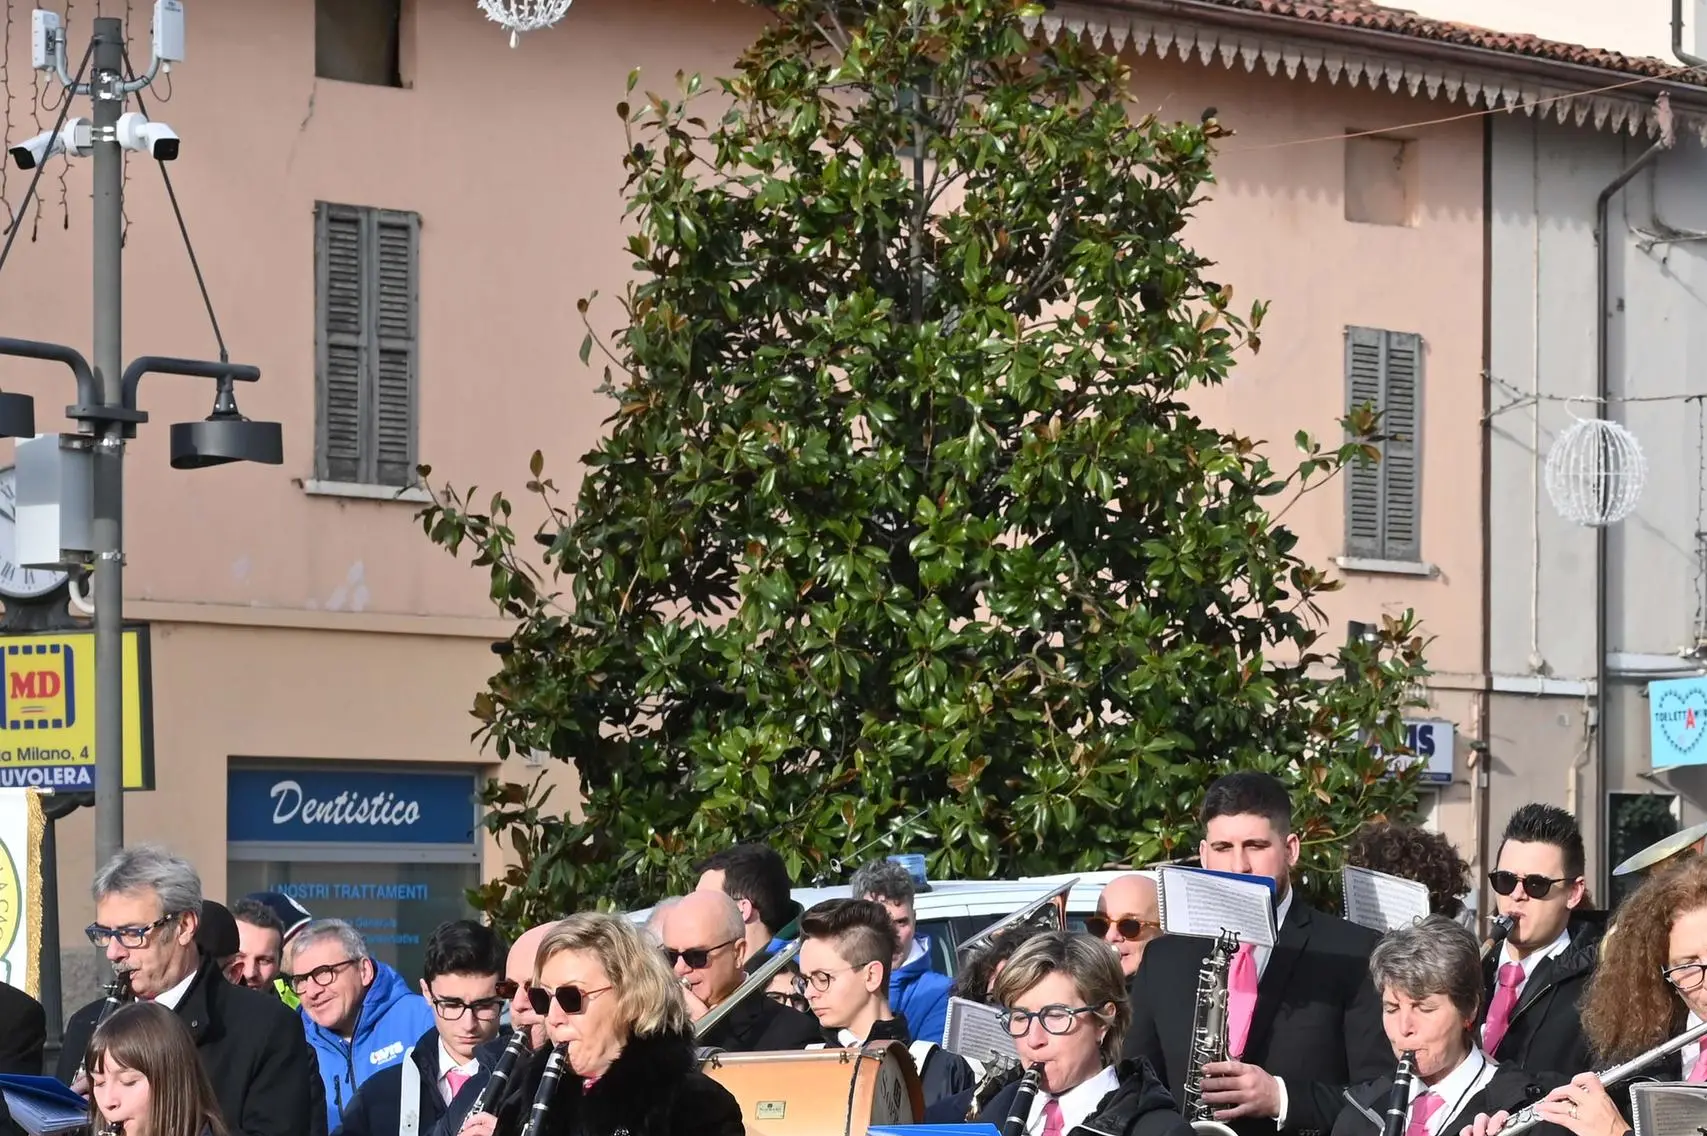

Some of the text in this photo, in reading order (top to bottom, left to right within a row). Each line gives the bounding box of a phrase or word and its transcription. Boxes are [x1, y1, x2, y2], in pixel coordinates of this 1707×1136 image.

[10, 670, 61, 700] MD
[0, 746, 89, 762] a Milano, 4
[0, 766, 91, 787] UVOLERA
[270, 780, 421, 827] Dentistico
[278, 884, 330, 899] NOSTRI
[334, 884, 428, 900] TRATTAMENTI
